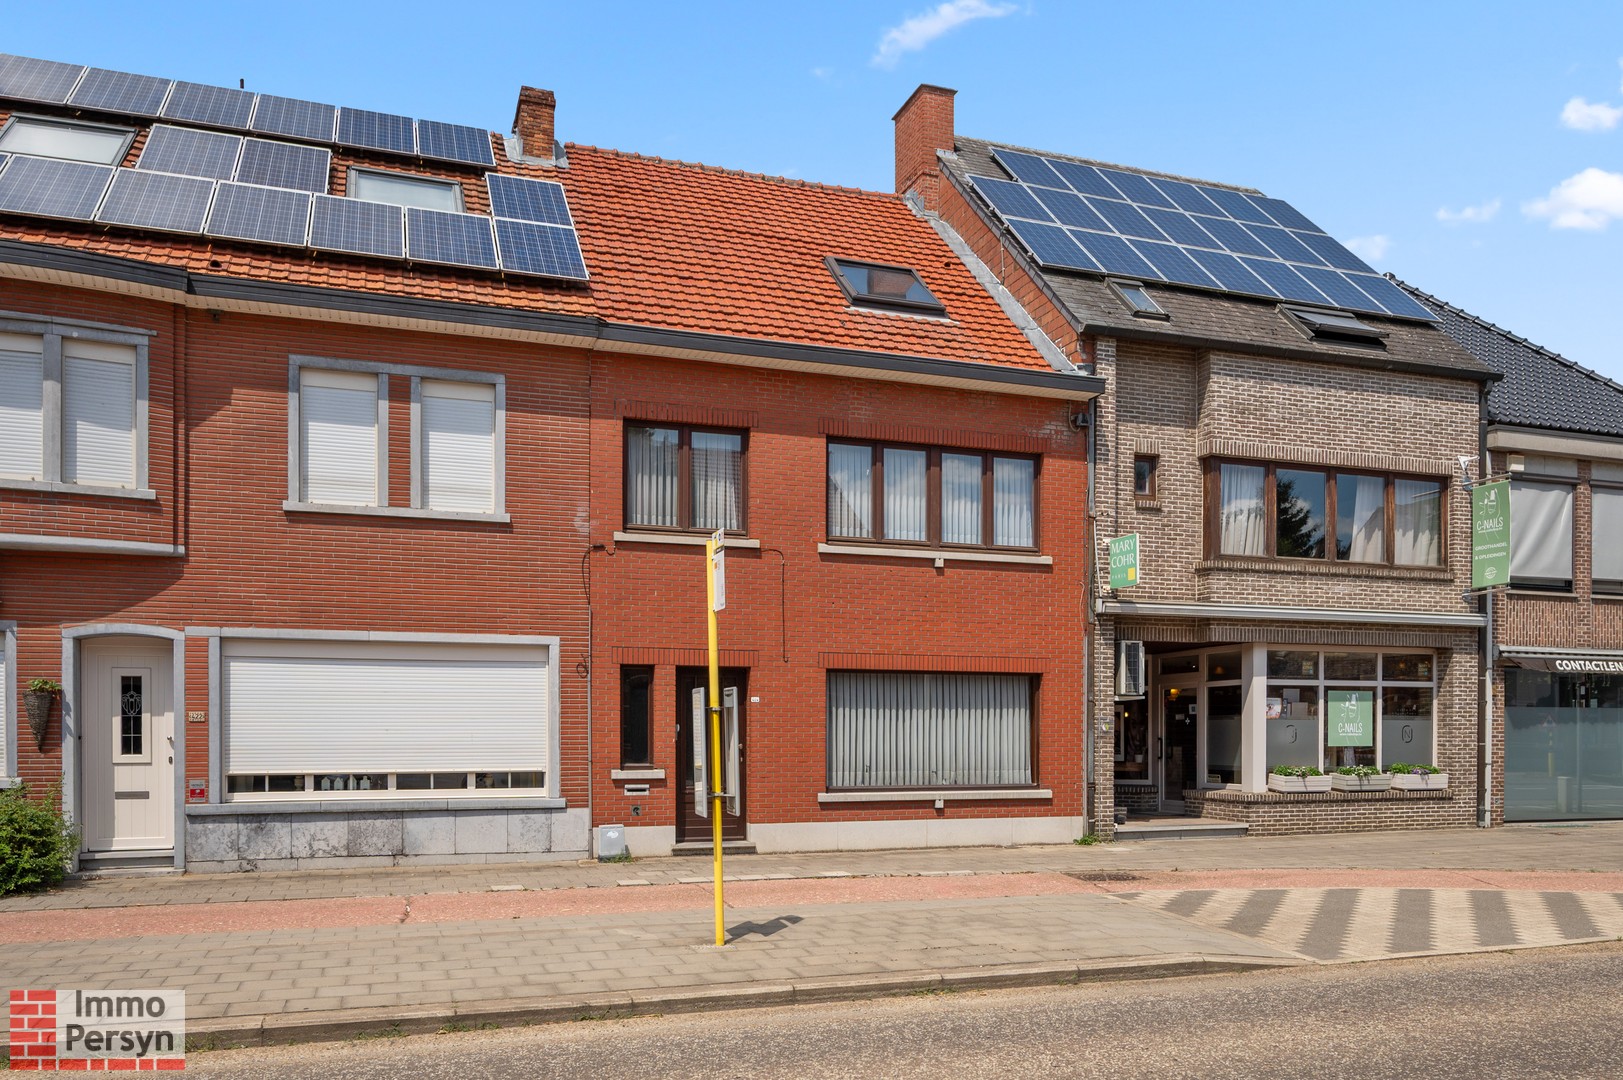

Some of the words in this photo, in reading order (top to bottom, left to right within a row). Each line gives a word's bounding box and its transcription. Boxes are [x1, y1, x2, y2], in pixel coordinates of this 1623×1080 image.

[1476, 516, 1504, 531] C-NAILS
[1111, 538, 1135, 554] MARY
[1111, 553, 1135, 568] COHR
[1337, 722, 1363, 733] C-NAILS
